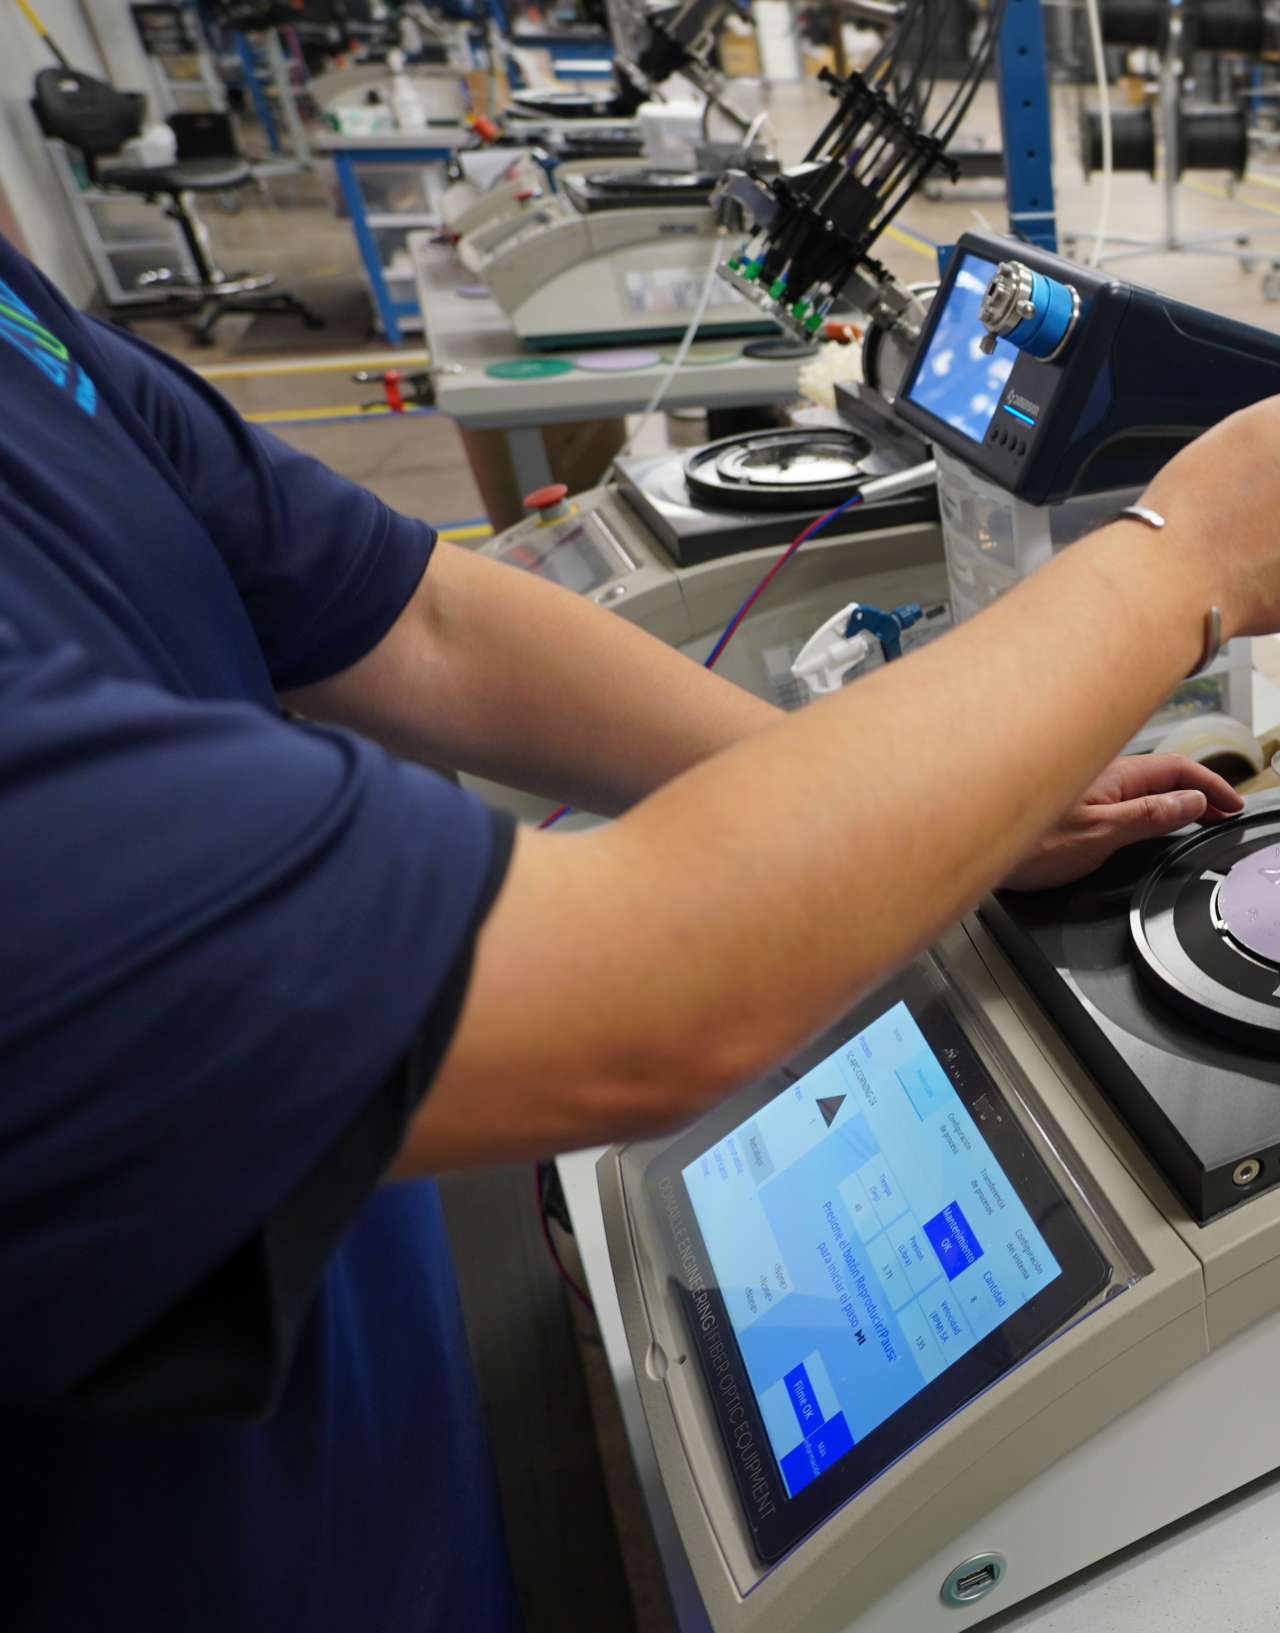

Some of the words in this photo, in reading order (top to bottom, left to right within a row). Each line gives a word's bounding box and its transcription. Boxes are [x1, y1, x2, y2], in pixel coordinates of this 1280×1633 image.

[858, 1035, 873, 1059] Proceso
[939, 1124, 947, 1134] de
[941, 1131, 959, 1155] proceso
[947, 1112, 972, 1151] Configuración
[749, 1136, 764, 1167] Retrabajo
[869, 1185, 882, 1203] (Seg)
[879, 1173, 893, 1198] Tiempo
[970, 1179, 979, 1190] de
[980, 1167, 1006, 1210] Transferencia
[973, 1187, 994, 1216] procesos
[822, 1200, 844, 1241] Presione
[942, 1206, 975, 1264] Mantenimiento
[815, 1241, 833, 1265] para
[838, 1238, 851, 1251] el
[897, 1244, 913, 1268] (Libra)
[941, 1237, 953, 1254] OK
[1015, 1228, 1044, 1276] Configuración
[842, 1246, 861, 1279] botón
[882, 1263, 894, 1280] 3.71
[1006, 1242, 1018, 1255] del
[1013, 1253, 1030, 1281] sistema
[827, 1261, 846, 1294] iniciar
[983, 1270, 1008, 1308] Cantidad
[839, 1291, 852, 1305] el
[840, 1302, 860, 1329] paso
[929, 1310, 945, 1335] (RPM)
[940, 1331, 950, 1345] SA
[941, 1299, 962, 1336] Velocidad
[658, 1176, 688, 1242] DOMAILLE
[677, 1237, 716, 1332] ENGINEERING
[706, 1331, 730, 1377] FIBER
[719, 1373, 745, 1424] OPTIC
[733, 1420, 777, 1520] EQUIPMENT
[915, 1335, 927, 1351] 135
[793, 1379, 808, 1407] Filme
[802, 1403, 815, 1421] OK
